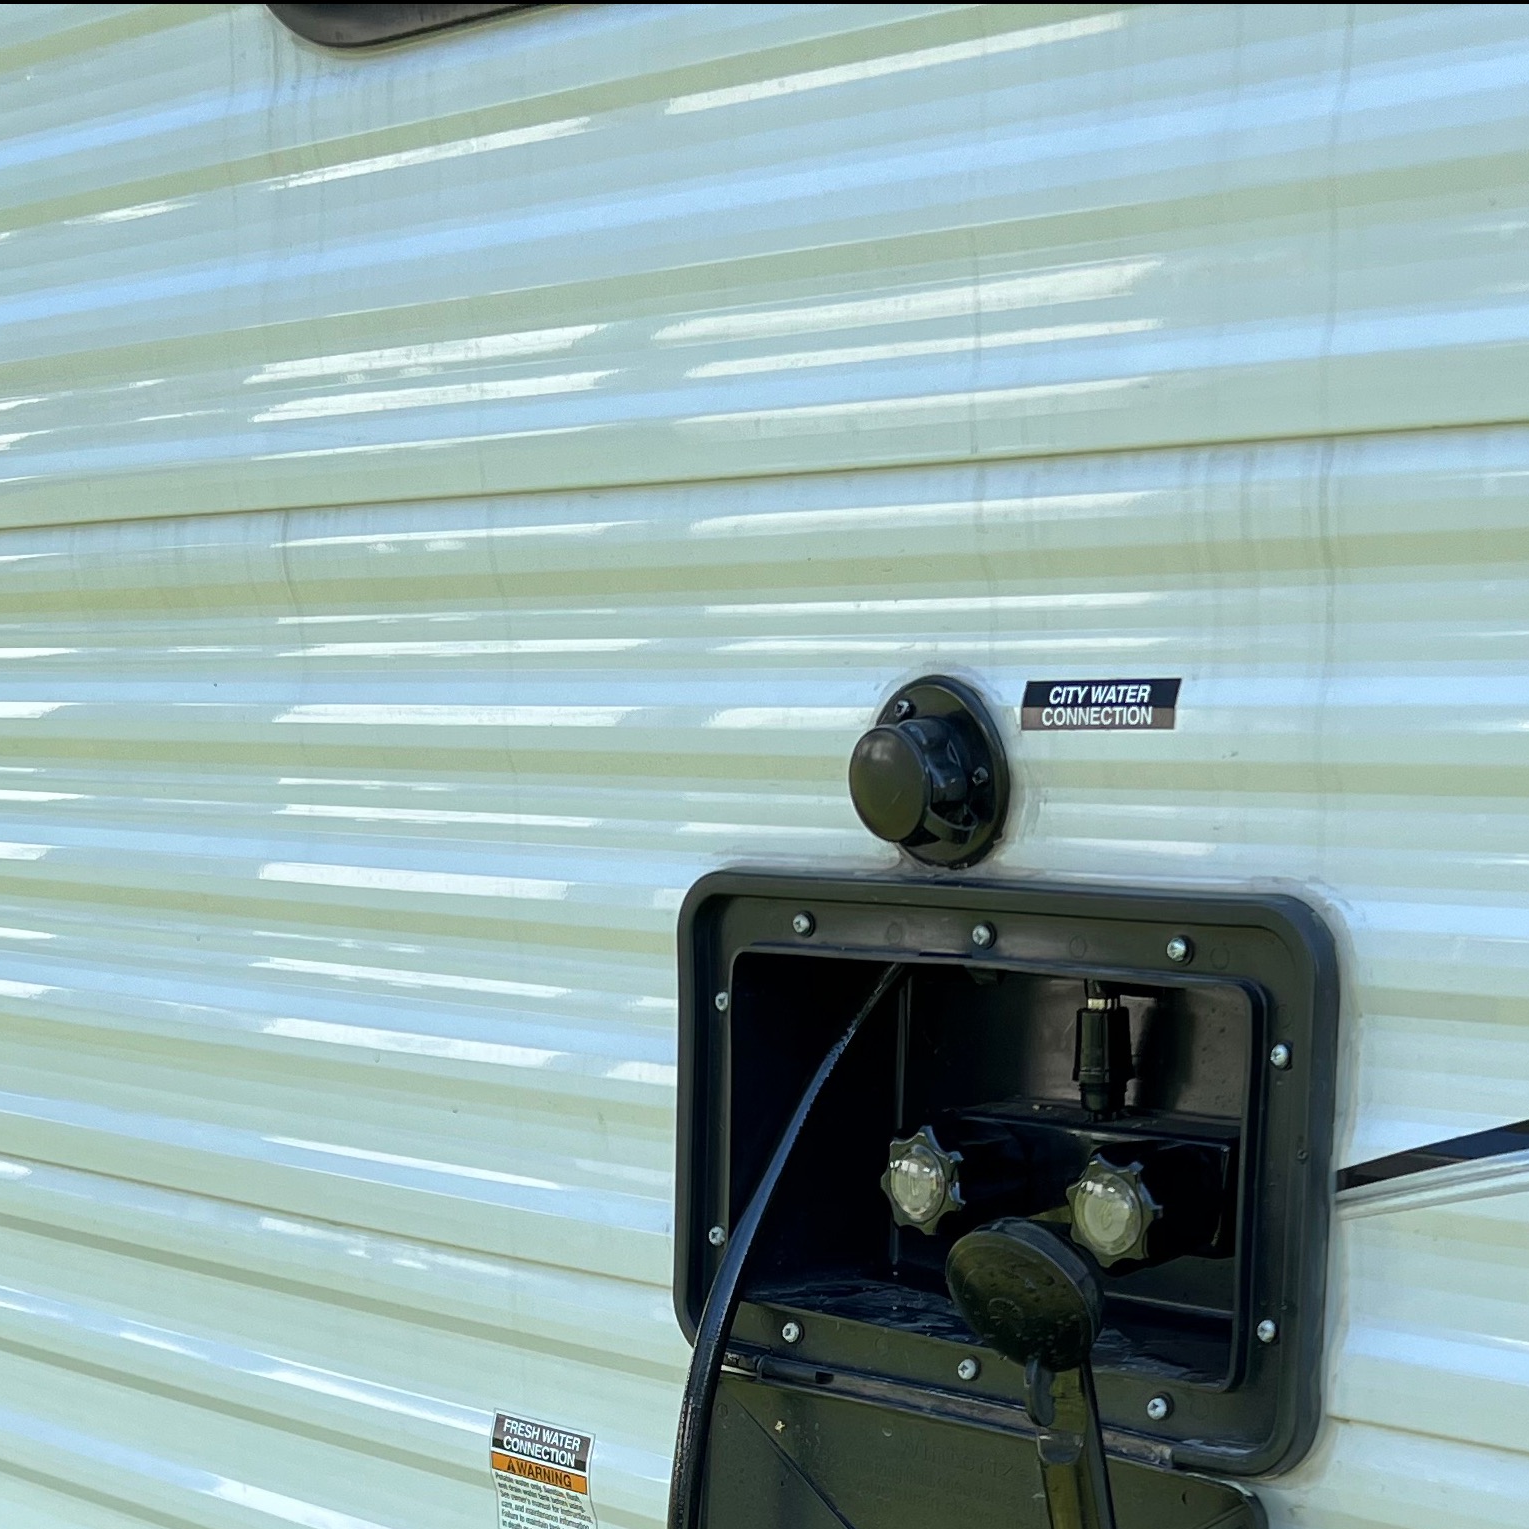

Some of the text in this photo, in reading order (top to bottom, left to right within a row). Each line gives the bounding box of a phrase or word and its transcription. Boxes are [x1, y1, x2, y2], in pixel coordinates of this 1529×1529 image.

[1049, 685, 1151, 705] CITY WATER
[1042, 707, 1152, 726] CONNECTION
[503, 1418, 581, 1451] FRESH WATER
[503, 1435, 576, 1467] CONNECTION
[517, 1460, 571, 1488] WARNING
[508, 1521, 522, 1529] death
